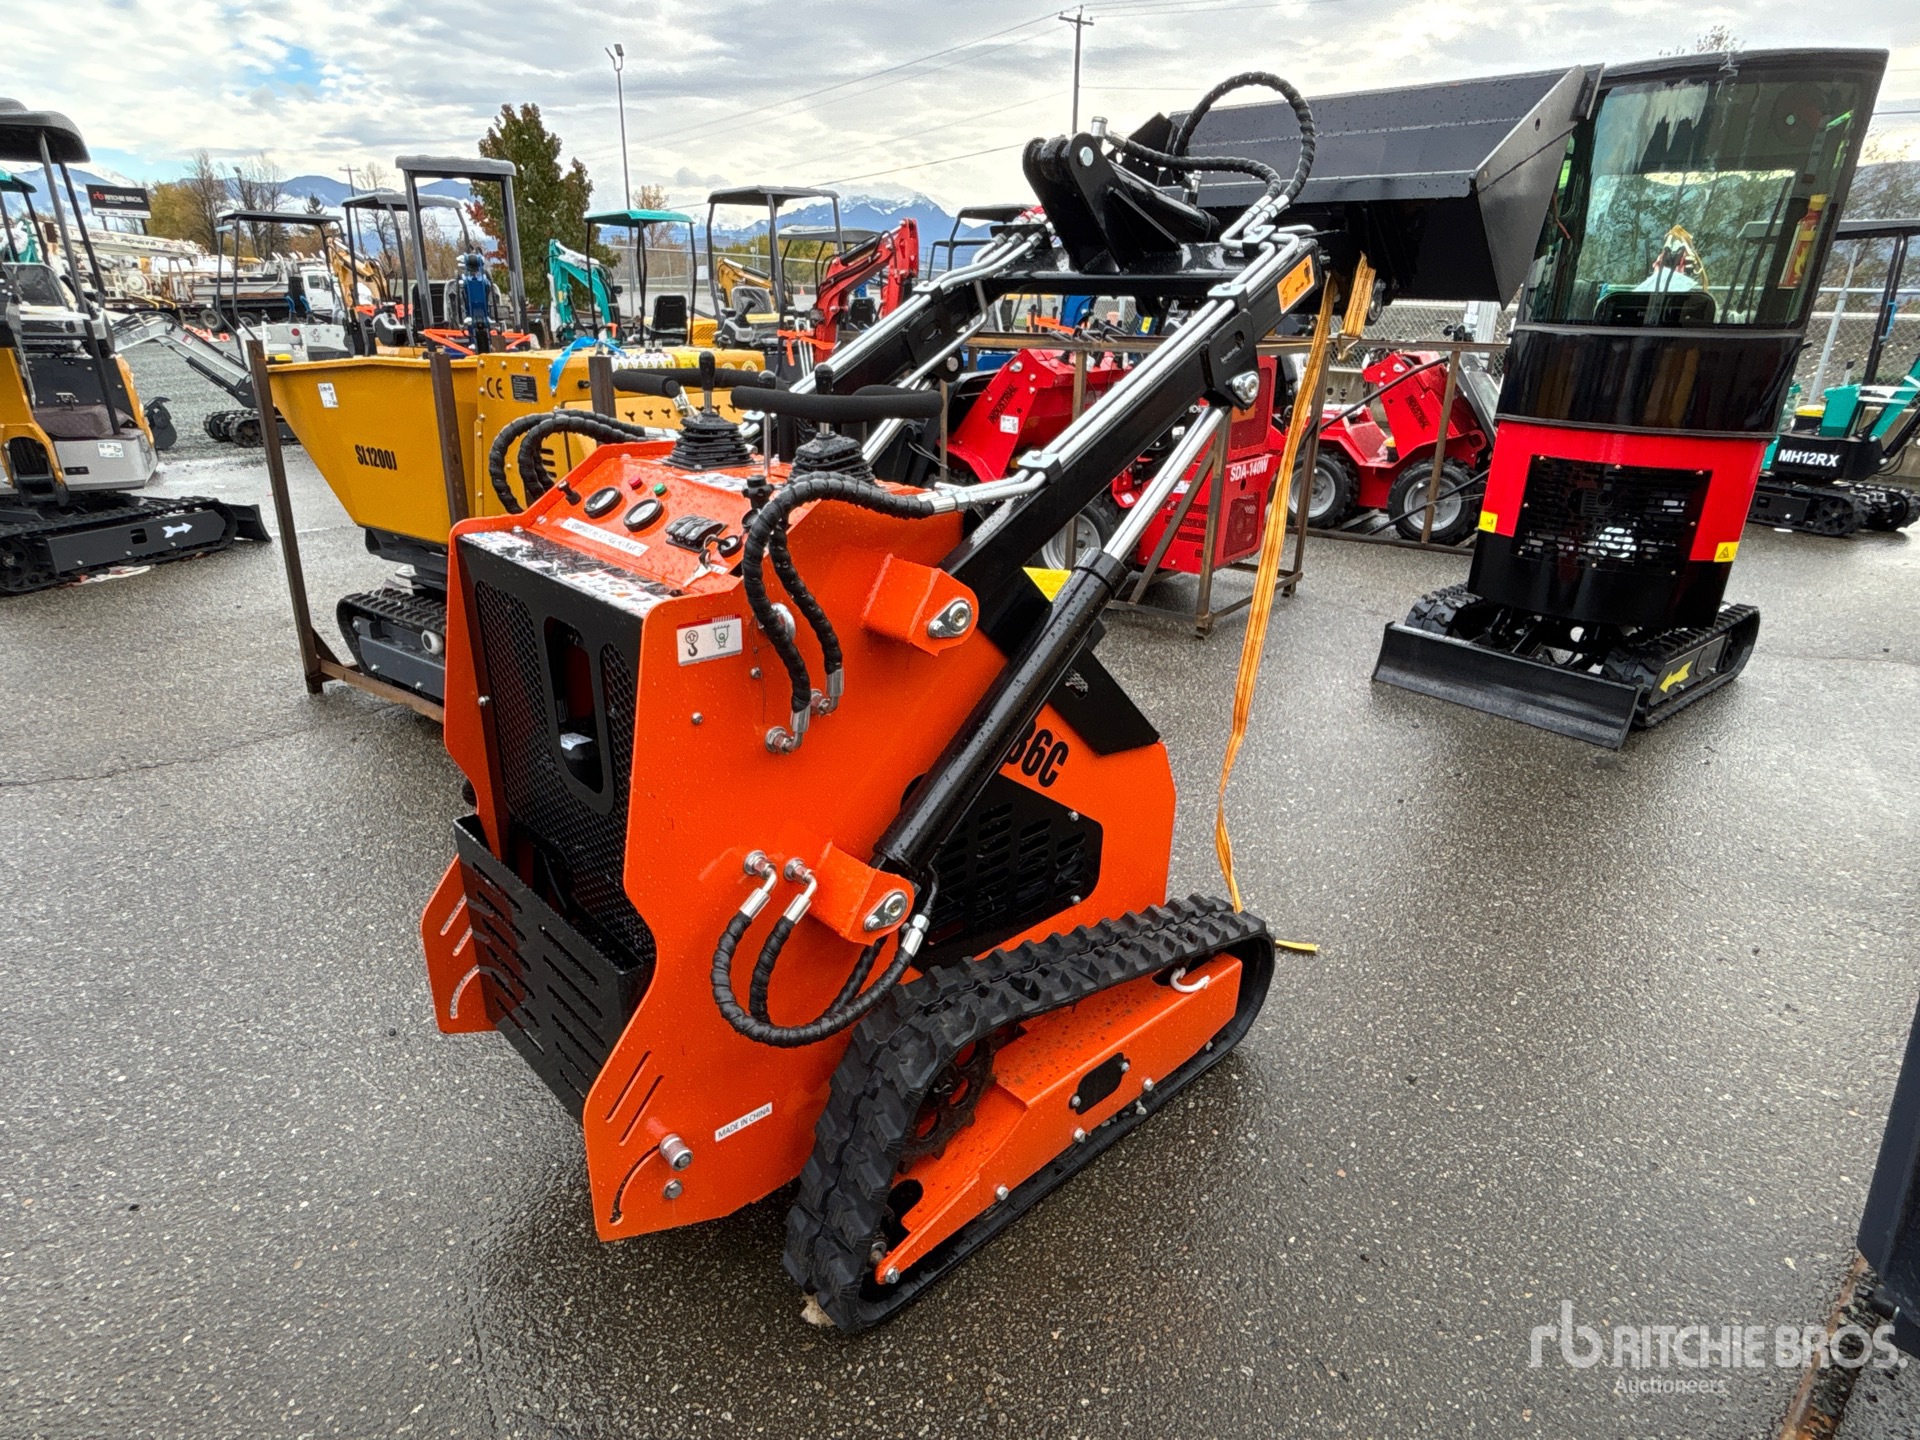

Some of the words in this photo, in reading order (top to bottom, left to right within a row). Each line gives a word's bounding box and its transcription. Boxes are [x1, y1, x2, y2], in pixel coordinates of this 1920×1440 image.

[354, 444, 398, 471] SL1200J
[1230, 457, 1269, 482] SDA-140W
[1778, 449, 1840, 467] MH12RX
[717, 1121, 739, 1138] MADE
[740, 1116, 749, 1127] IN
[749, 1106, 770, 1122] CHINA
